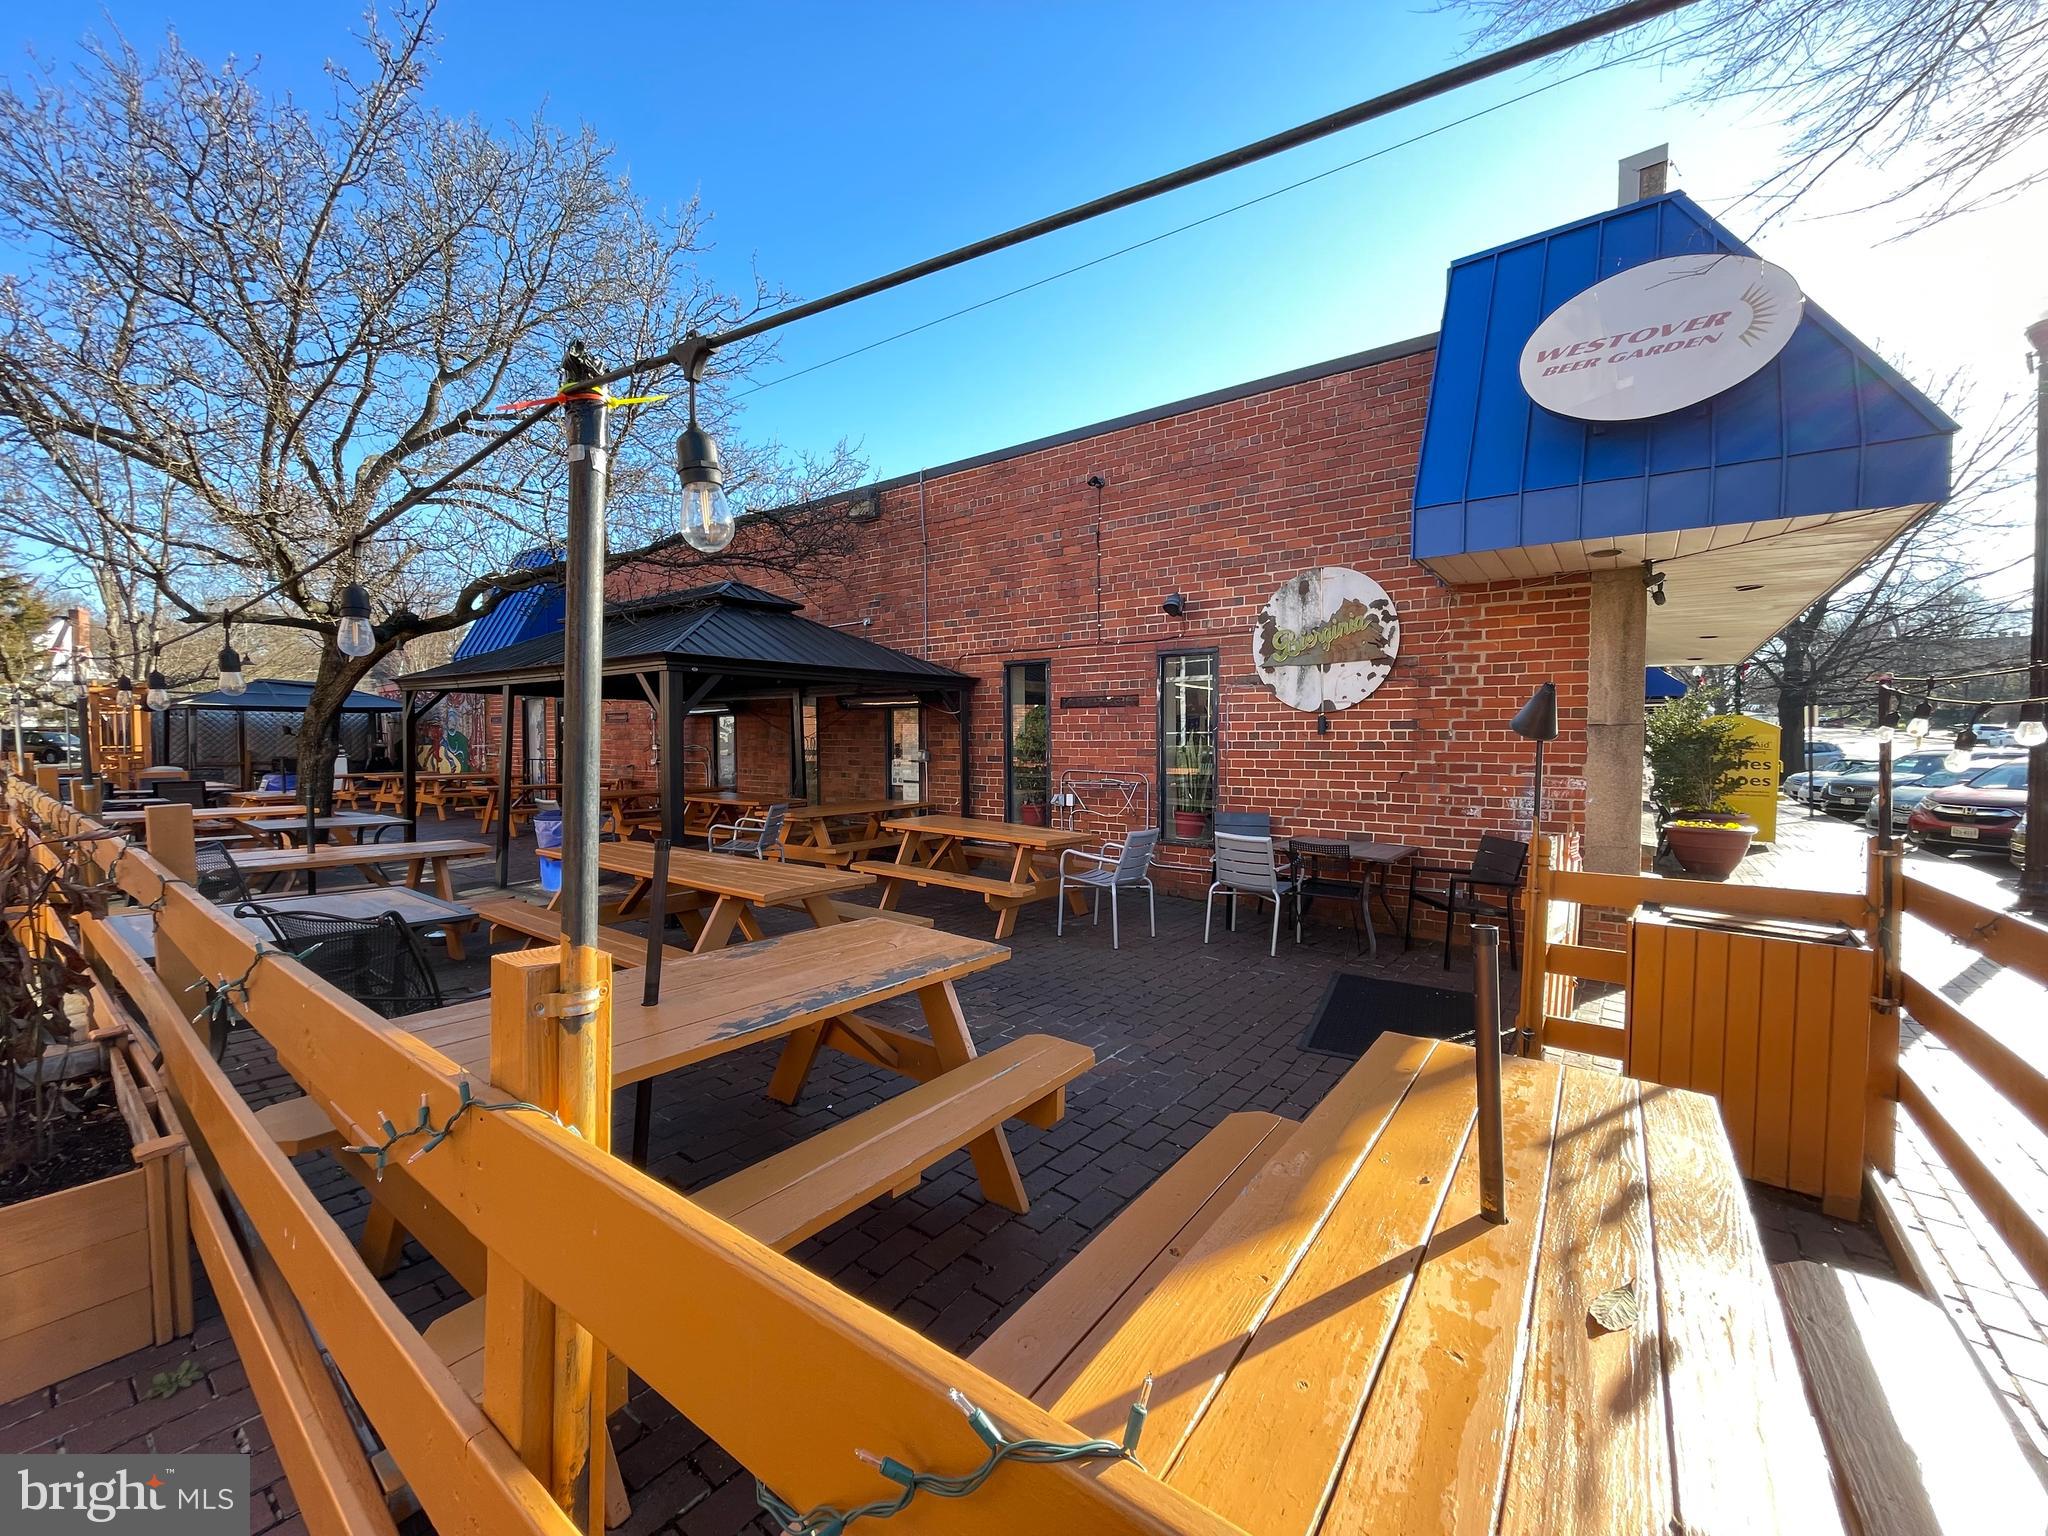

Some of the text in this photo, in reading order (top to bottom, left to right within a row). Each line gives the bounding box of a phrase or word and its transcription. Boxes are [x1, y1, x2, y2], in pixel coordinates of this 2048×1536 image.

[1536, 311, 1733, 364] WESTOVER
[1541, 332, 1724, 377] BEER GARDEN
